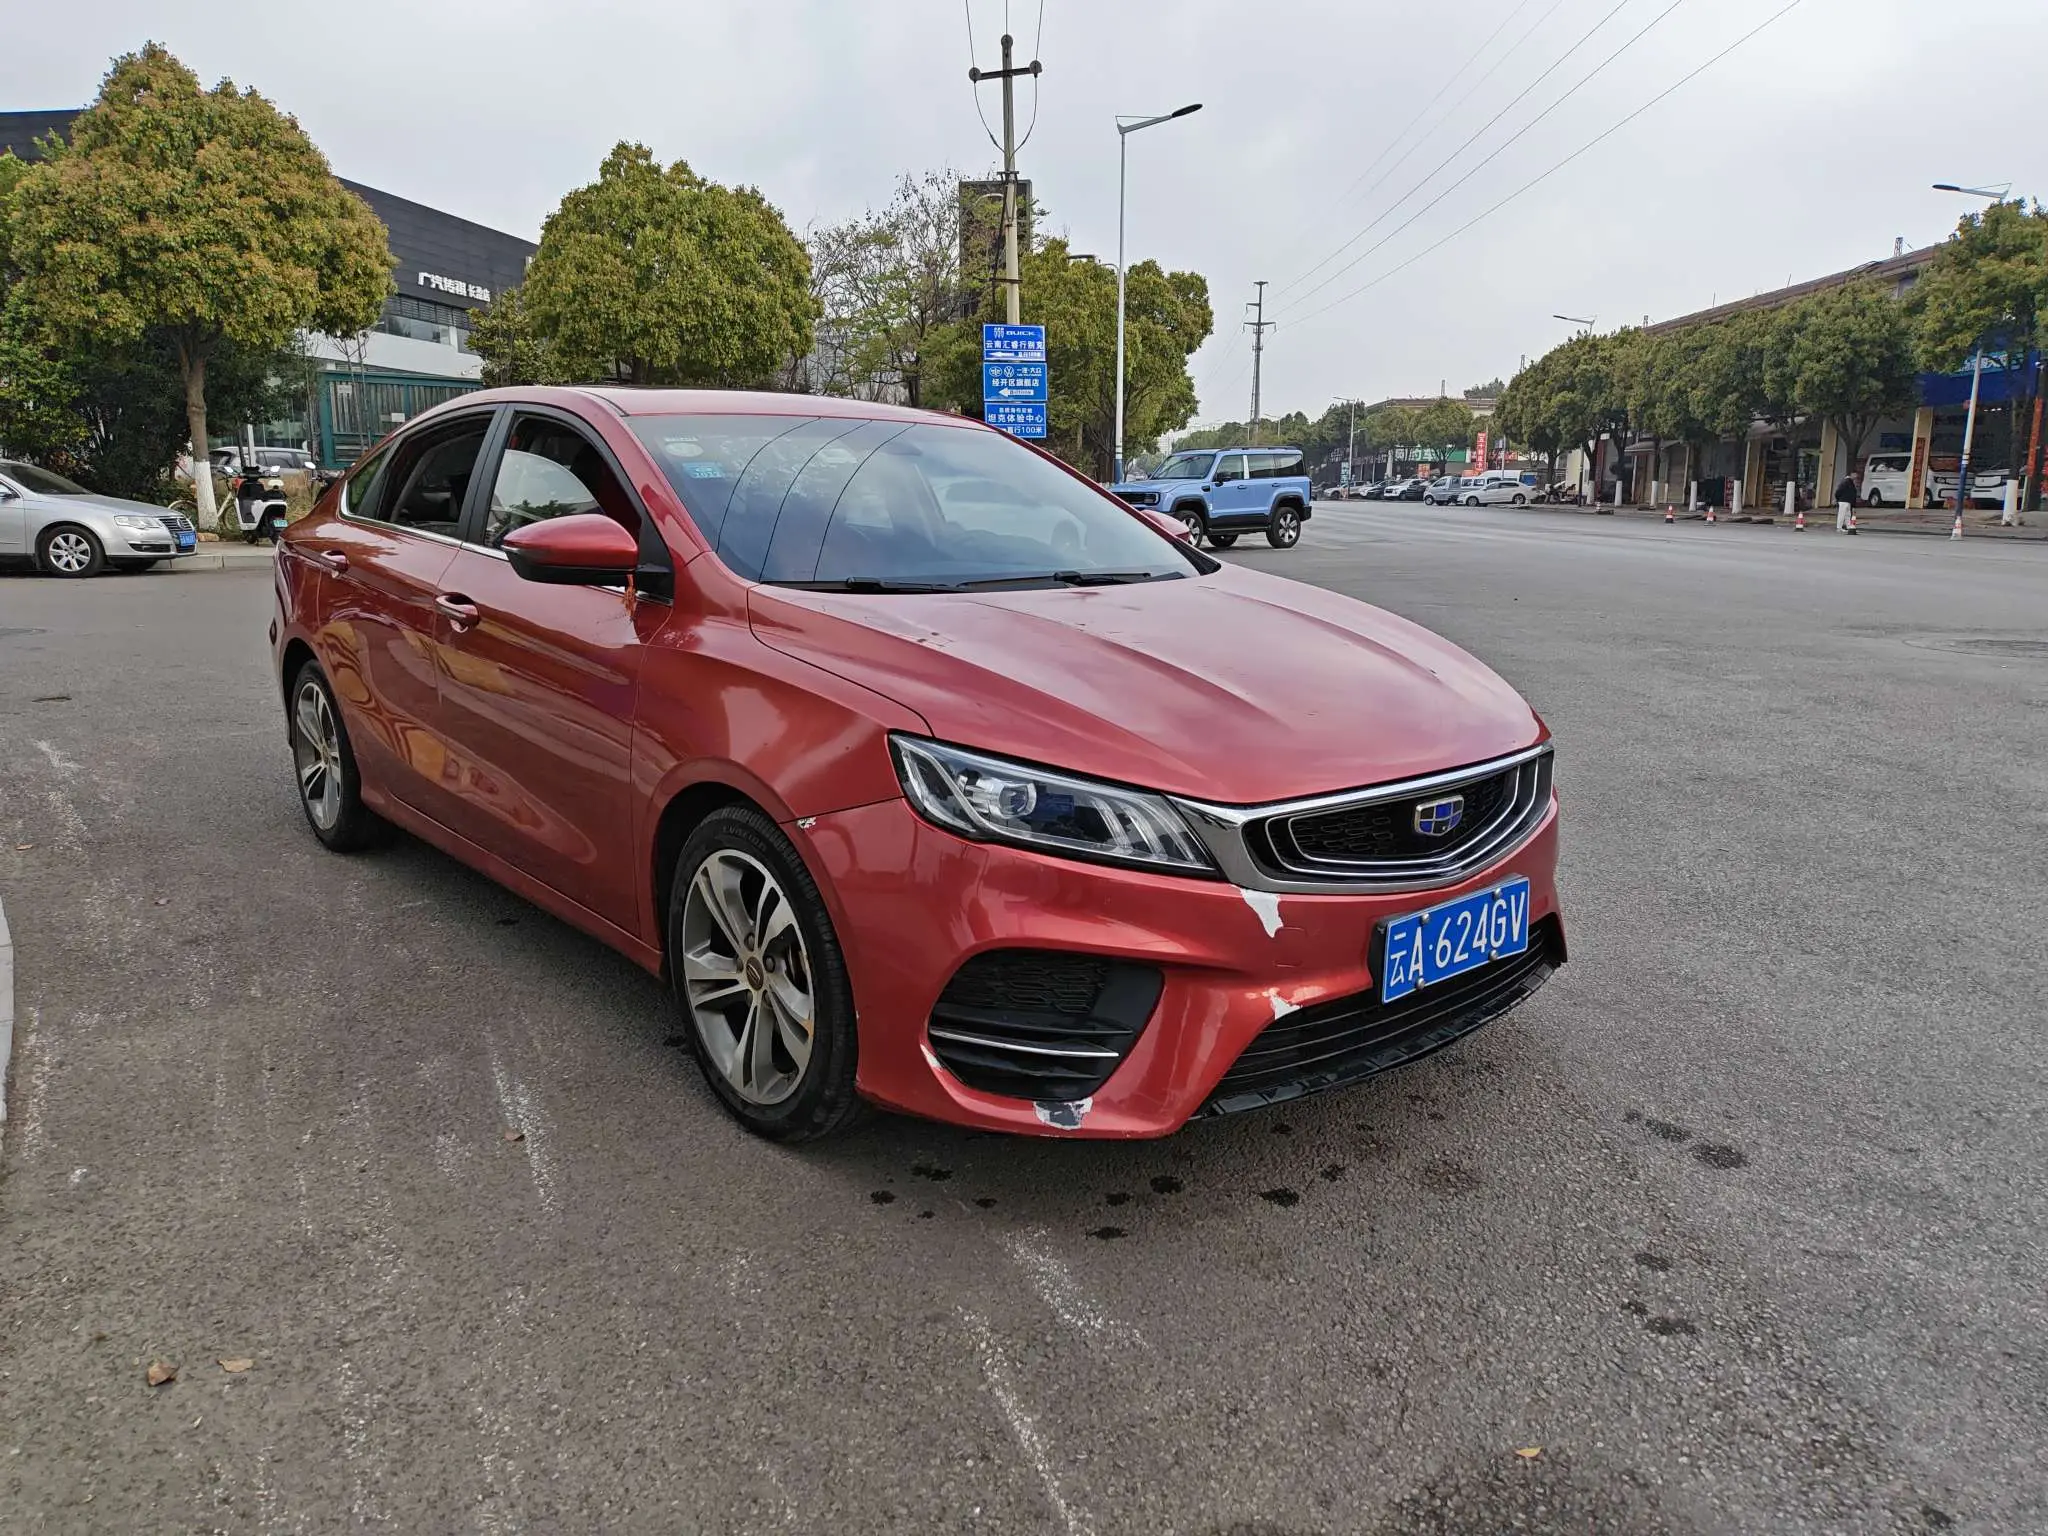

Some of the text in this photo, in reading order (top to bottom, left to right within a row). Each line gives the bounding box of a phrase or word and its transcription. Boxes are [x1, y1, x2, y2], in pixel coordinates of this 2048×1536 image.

[988, 413, 1044, 423] 坦克体验中心
